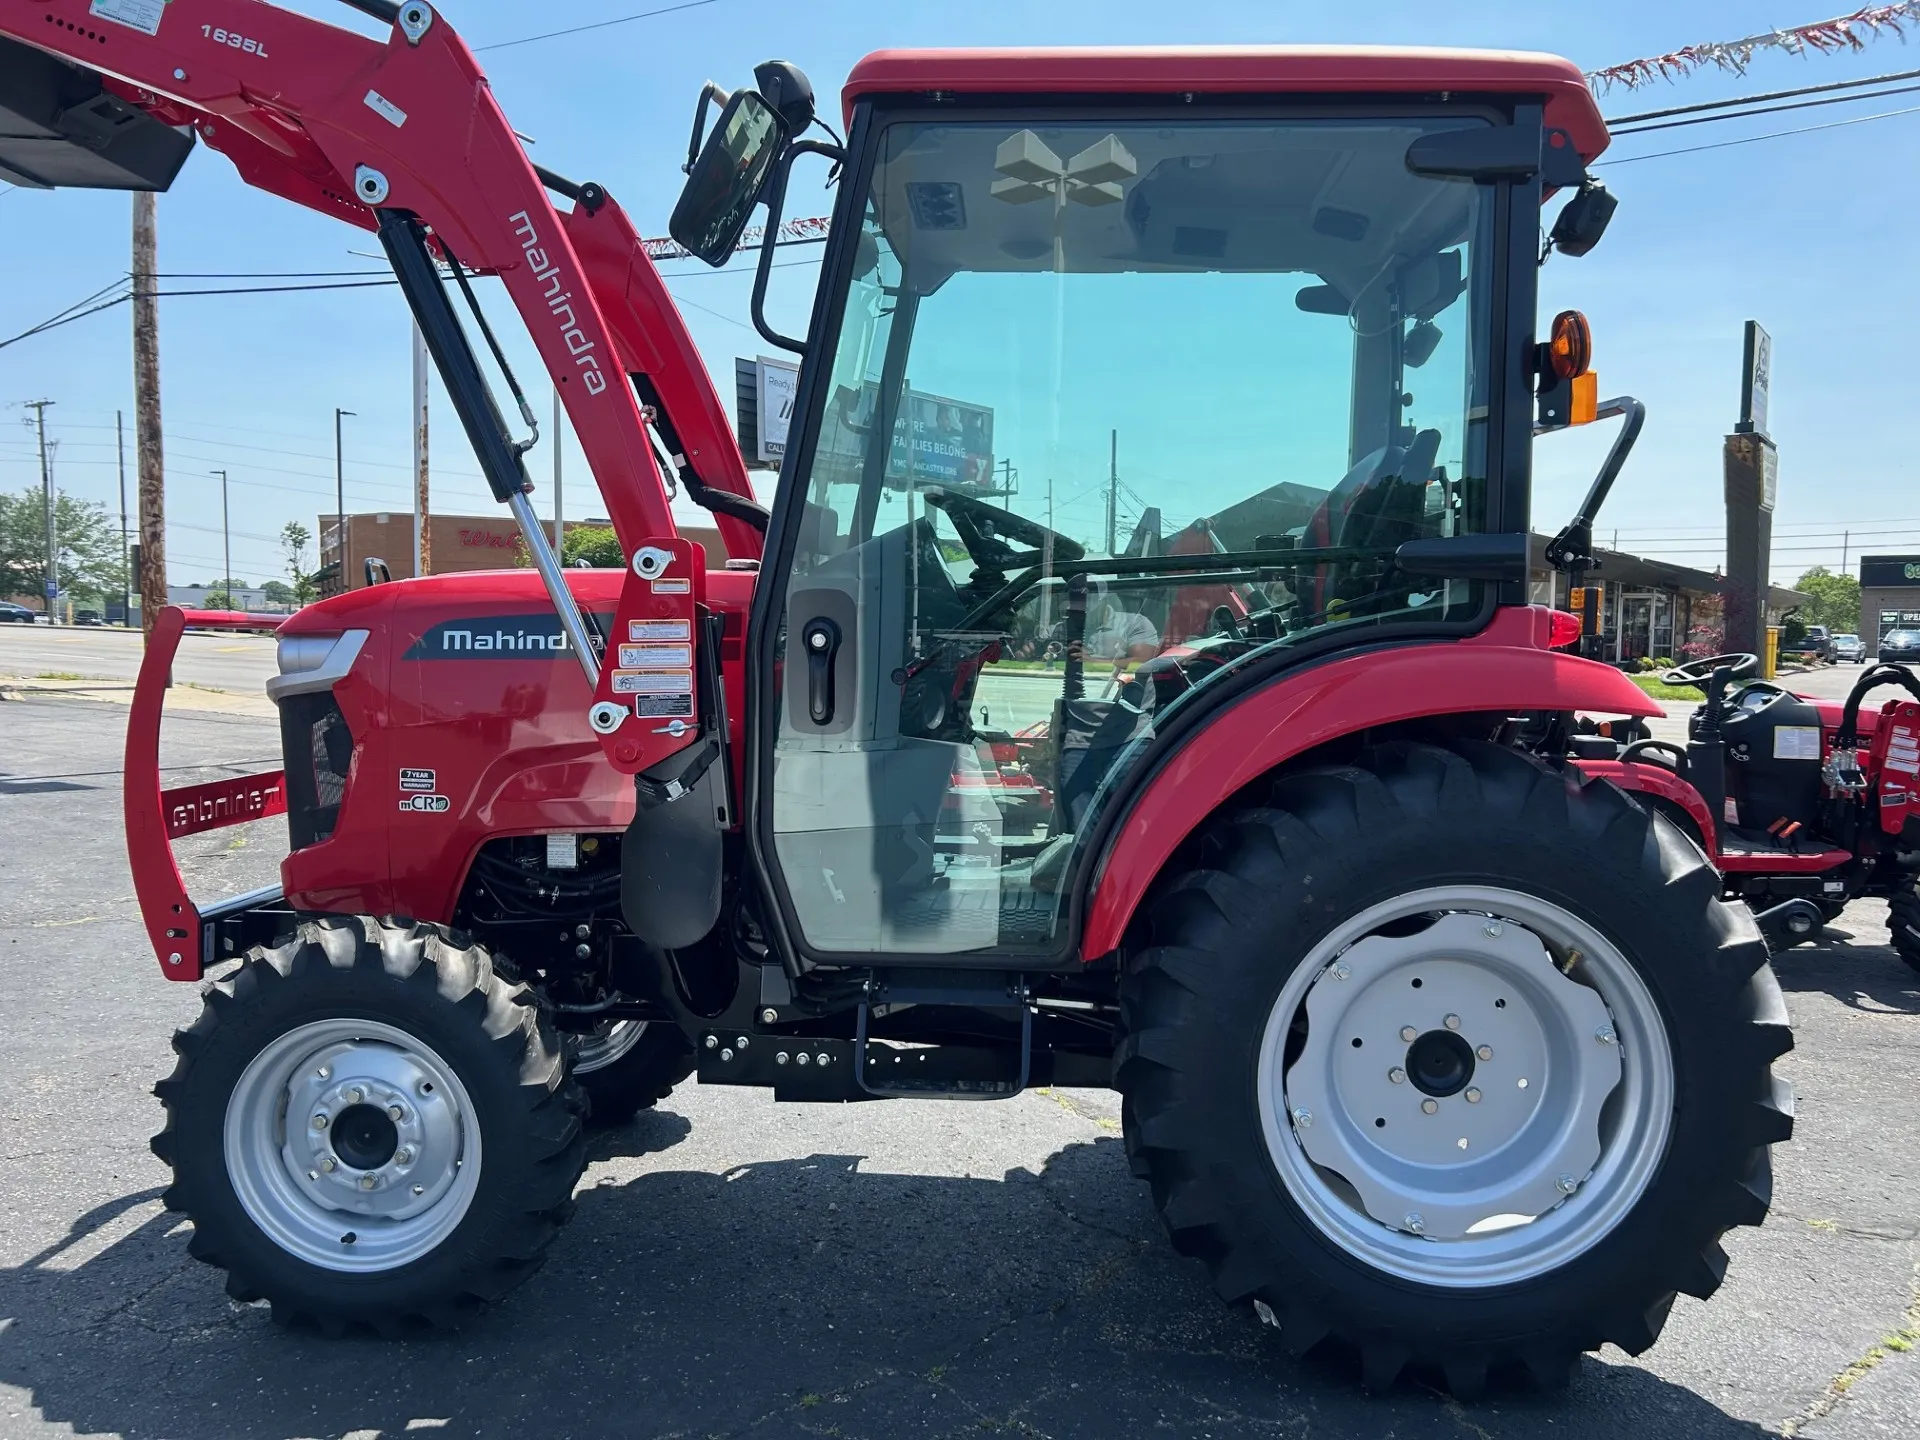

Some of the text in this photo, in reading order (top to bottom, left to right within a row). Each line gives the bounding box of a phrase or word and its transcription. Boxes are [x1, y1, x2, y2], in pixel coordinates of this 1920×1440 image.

[200, 24, 269, 59] 1635L
[508, 210, 607, 396] mahindra
[406, 770, 429, 779] 7 YEAR
